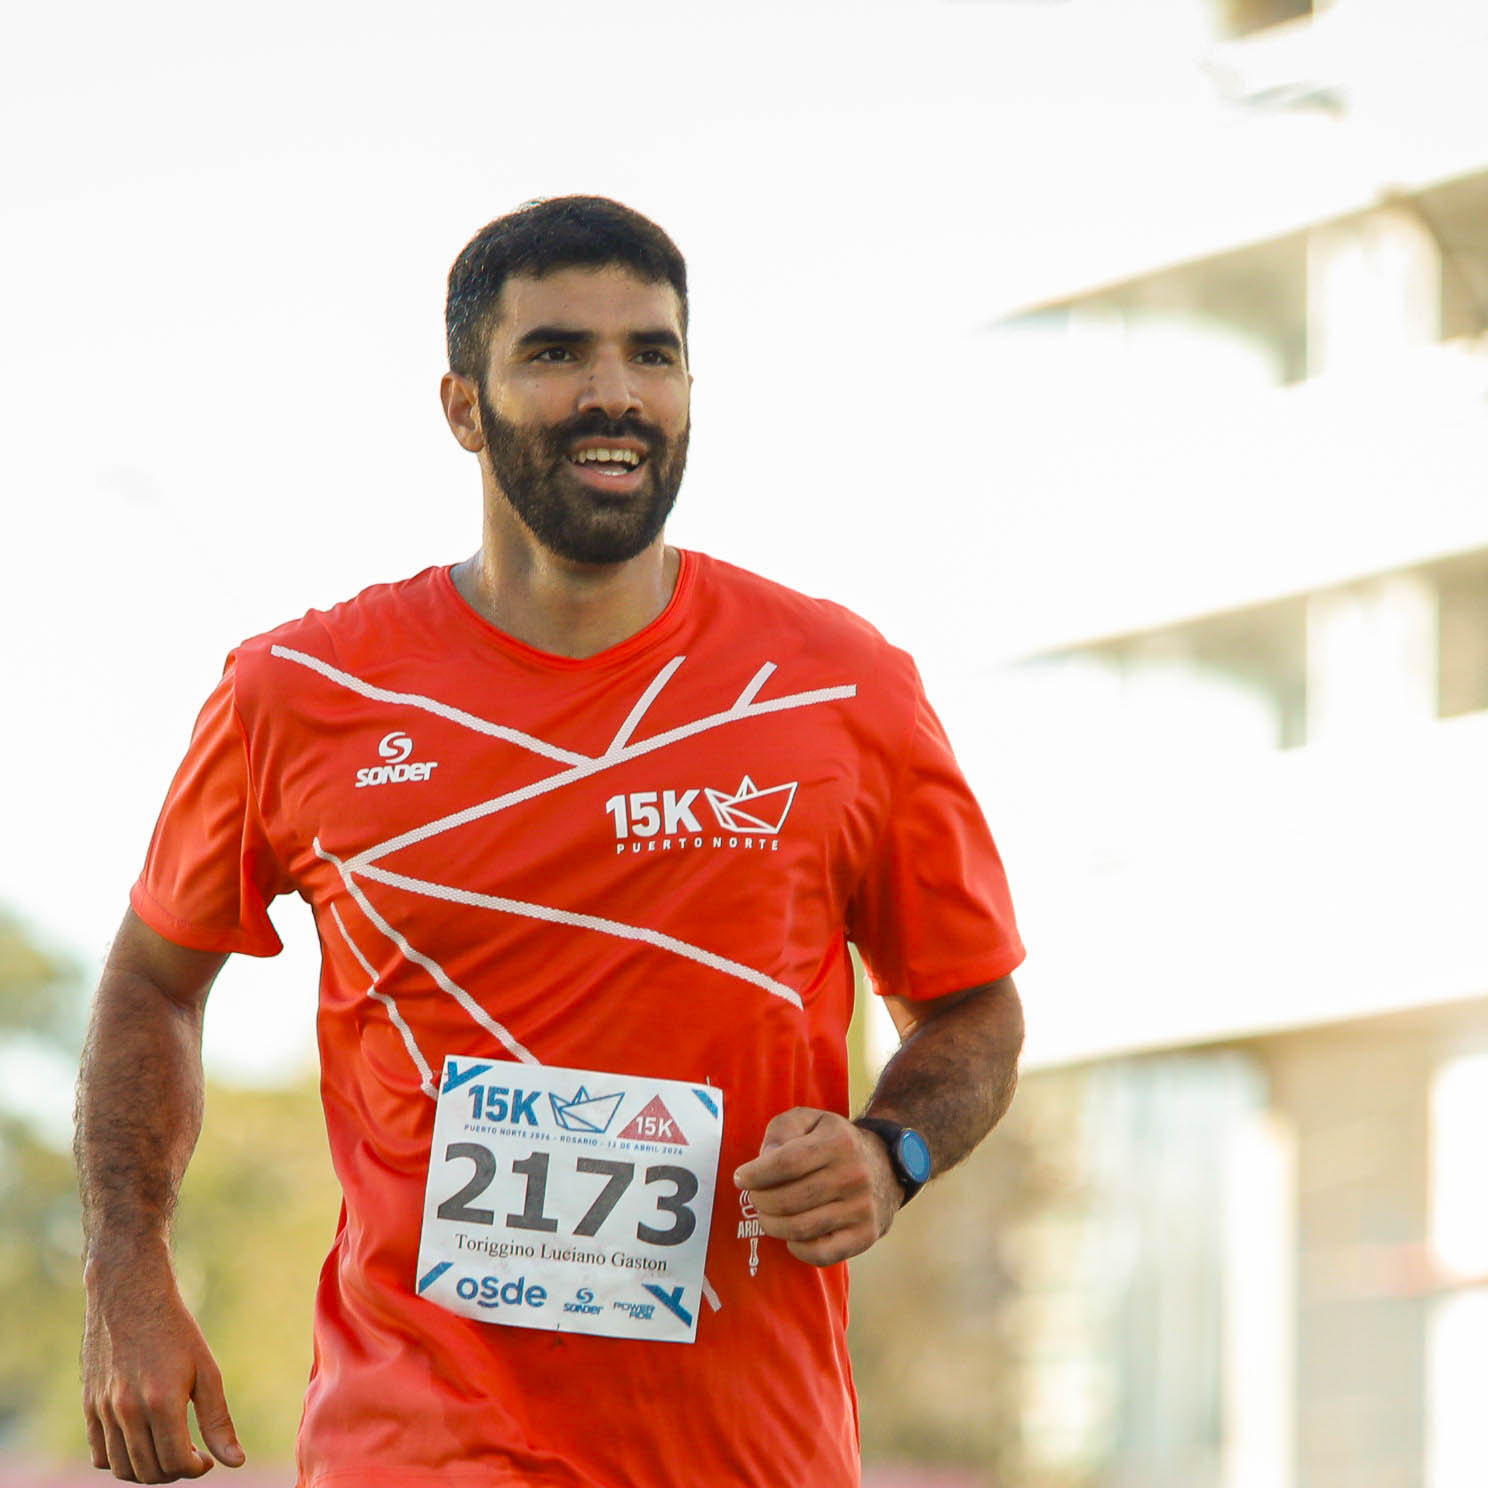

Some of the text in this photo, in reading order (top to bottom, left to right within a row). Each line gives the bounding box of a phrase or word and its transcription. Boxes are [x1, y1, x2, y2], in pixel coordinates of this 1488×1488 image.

[605, 789, 703, 839] 15K
[616, 836, 779, 855] PUERTO NORTE
[468, 1084, 541, 1127] 15K
[464, 1124, 497, 1135] PUERTO
[500, 1128, 527, 1138] NORTE
[560, 1135, 598, 1146] ROSARIO
[635, 1115, 674, 1139] 15K
[436, 1142, 699, 1247] 2173
[455, 1233, 668, 1271] Toriggino Luciano Gaston
[456, 1276, 548, 1309] osde
